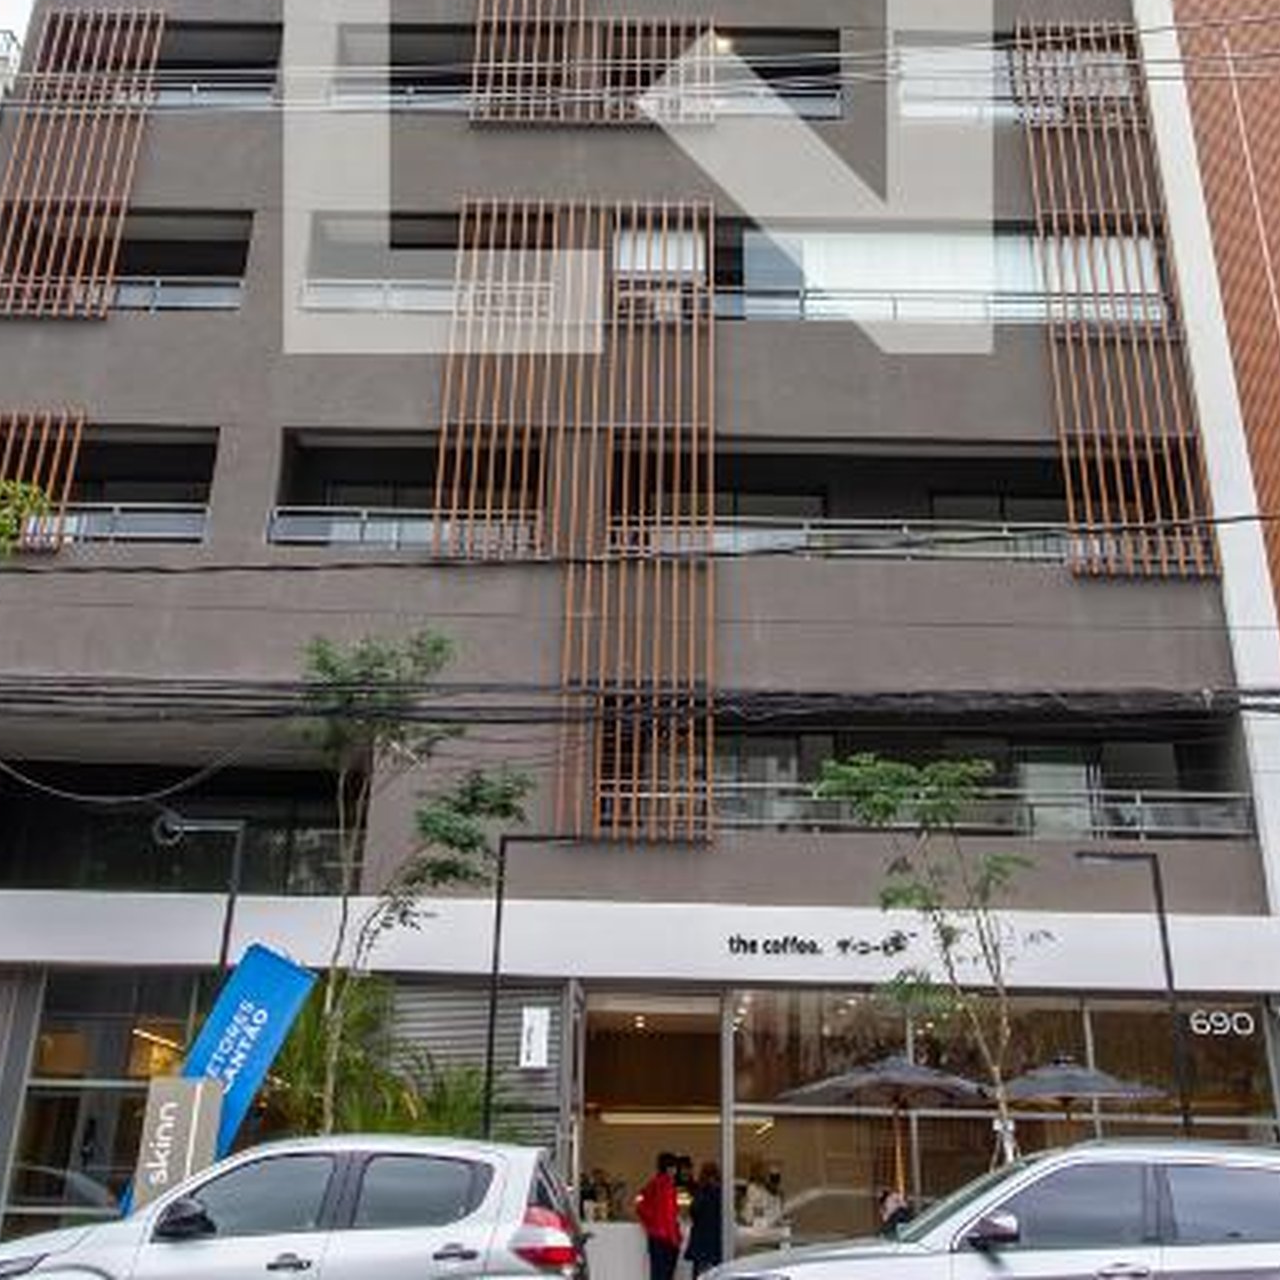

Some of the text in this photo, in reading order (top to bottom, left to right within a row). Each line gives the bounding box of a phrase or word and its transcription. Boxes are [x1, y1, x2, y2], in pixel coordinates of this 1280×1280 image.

[728, 934, 757, 954] the
[1189, 1009, 1254, 1035] 690
[145, 1102, 178, 1184] skinn
